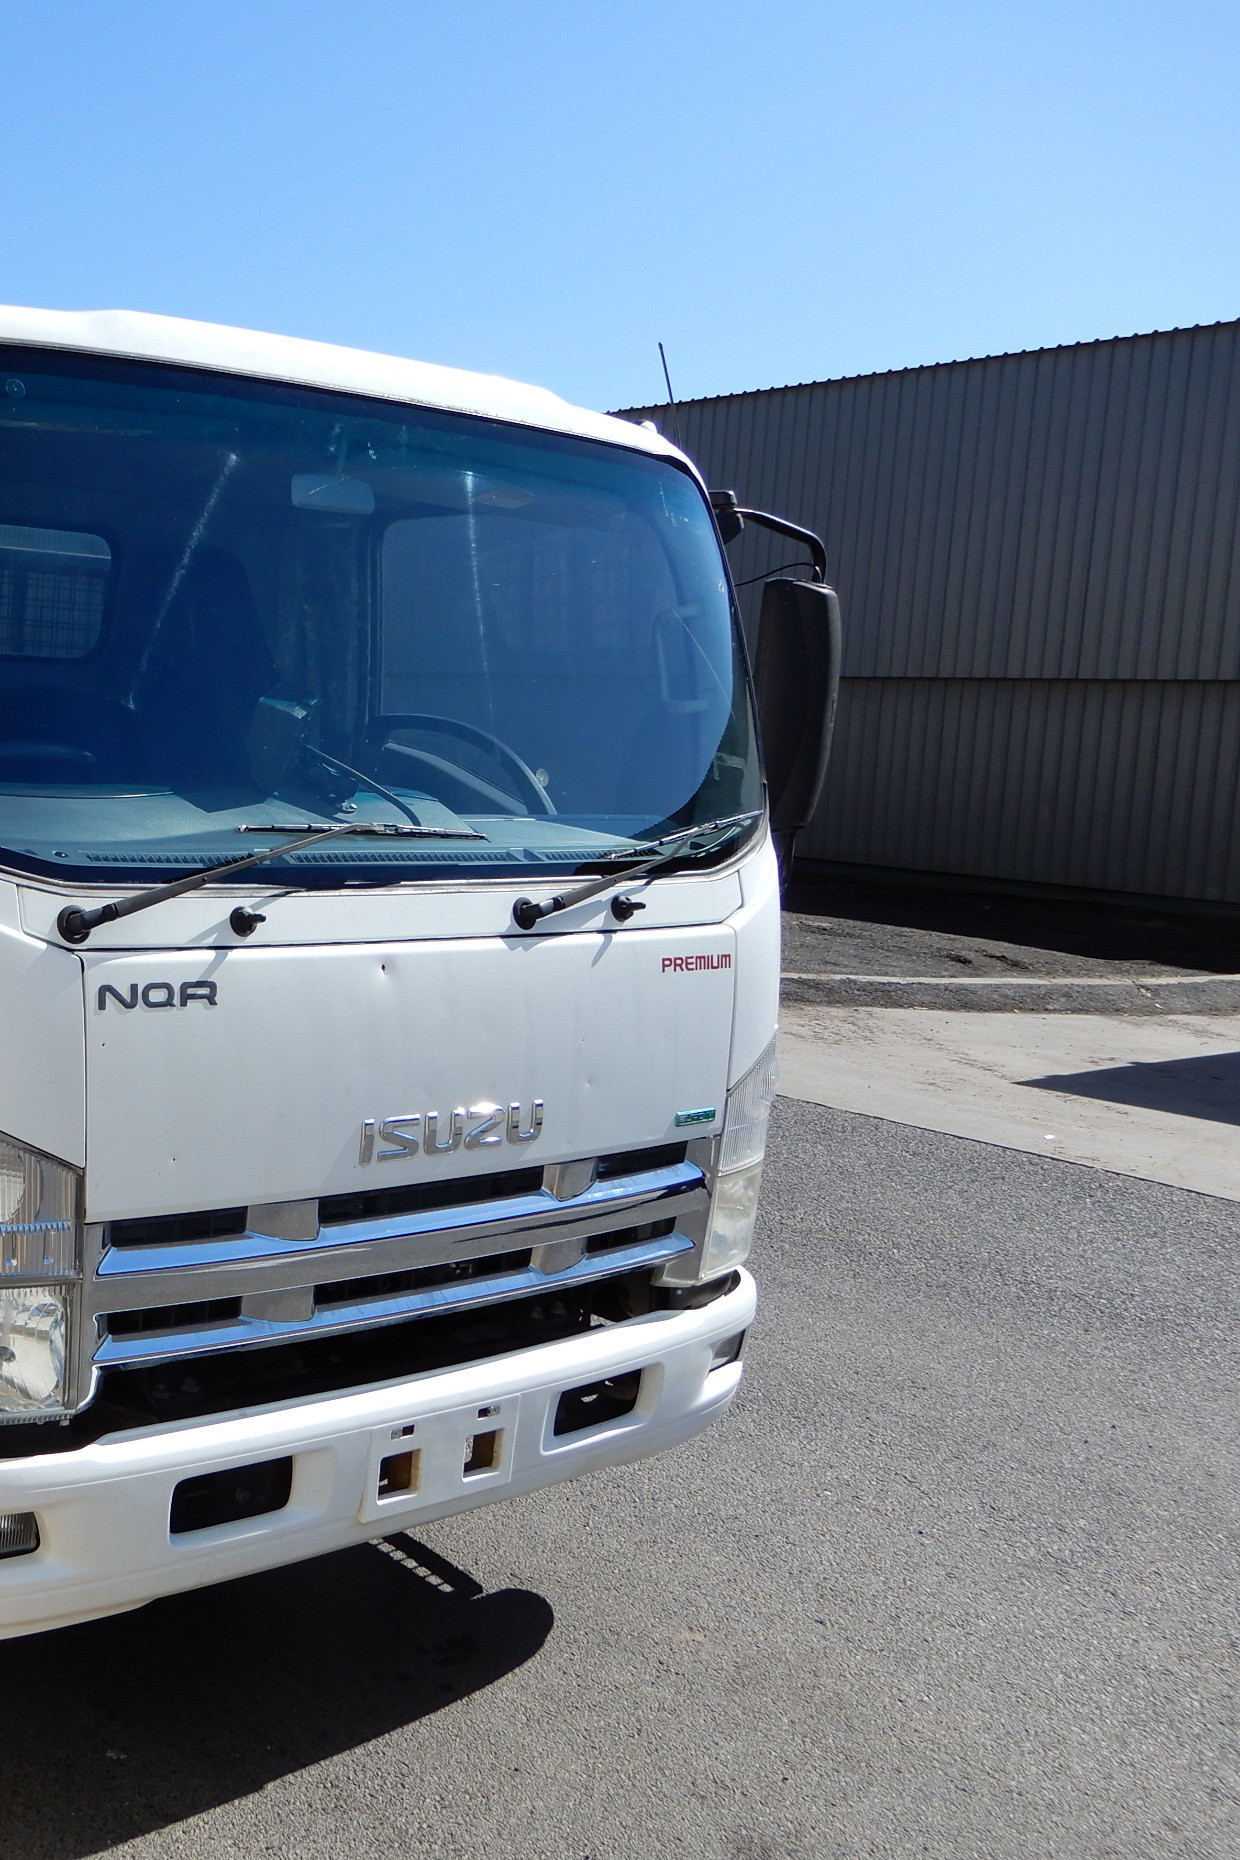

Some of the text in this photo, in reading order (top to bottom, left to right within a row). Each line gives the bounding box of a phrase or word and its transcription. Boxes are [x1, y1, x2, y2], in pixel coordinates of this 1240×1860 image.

[661, 953, 732, 973] PREMIUM
[97, 980, 218, 1011] NQR
[358, 1098, 545, 1165] ISUZU
